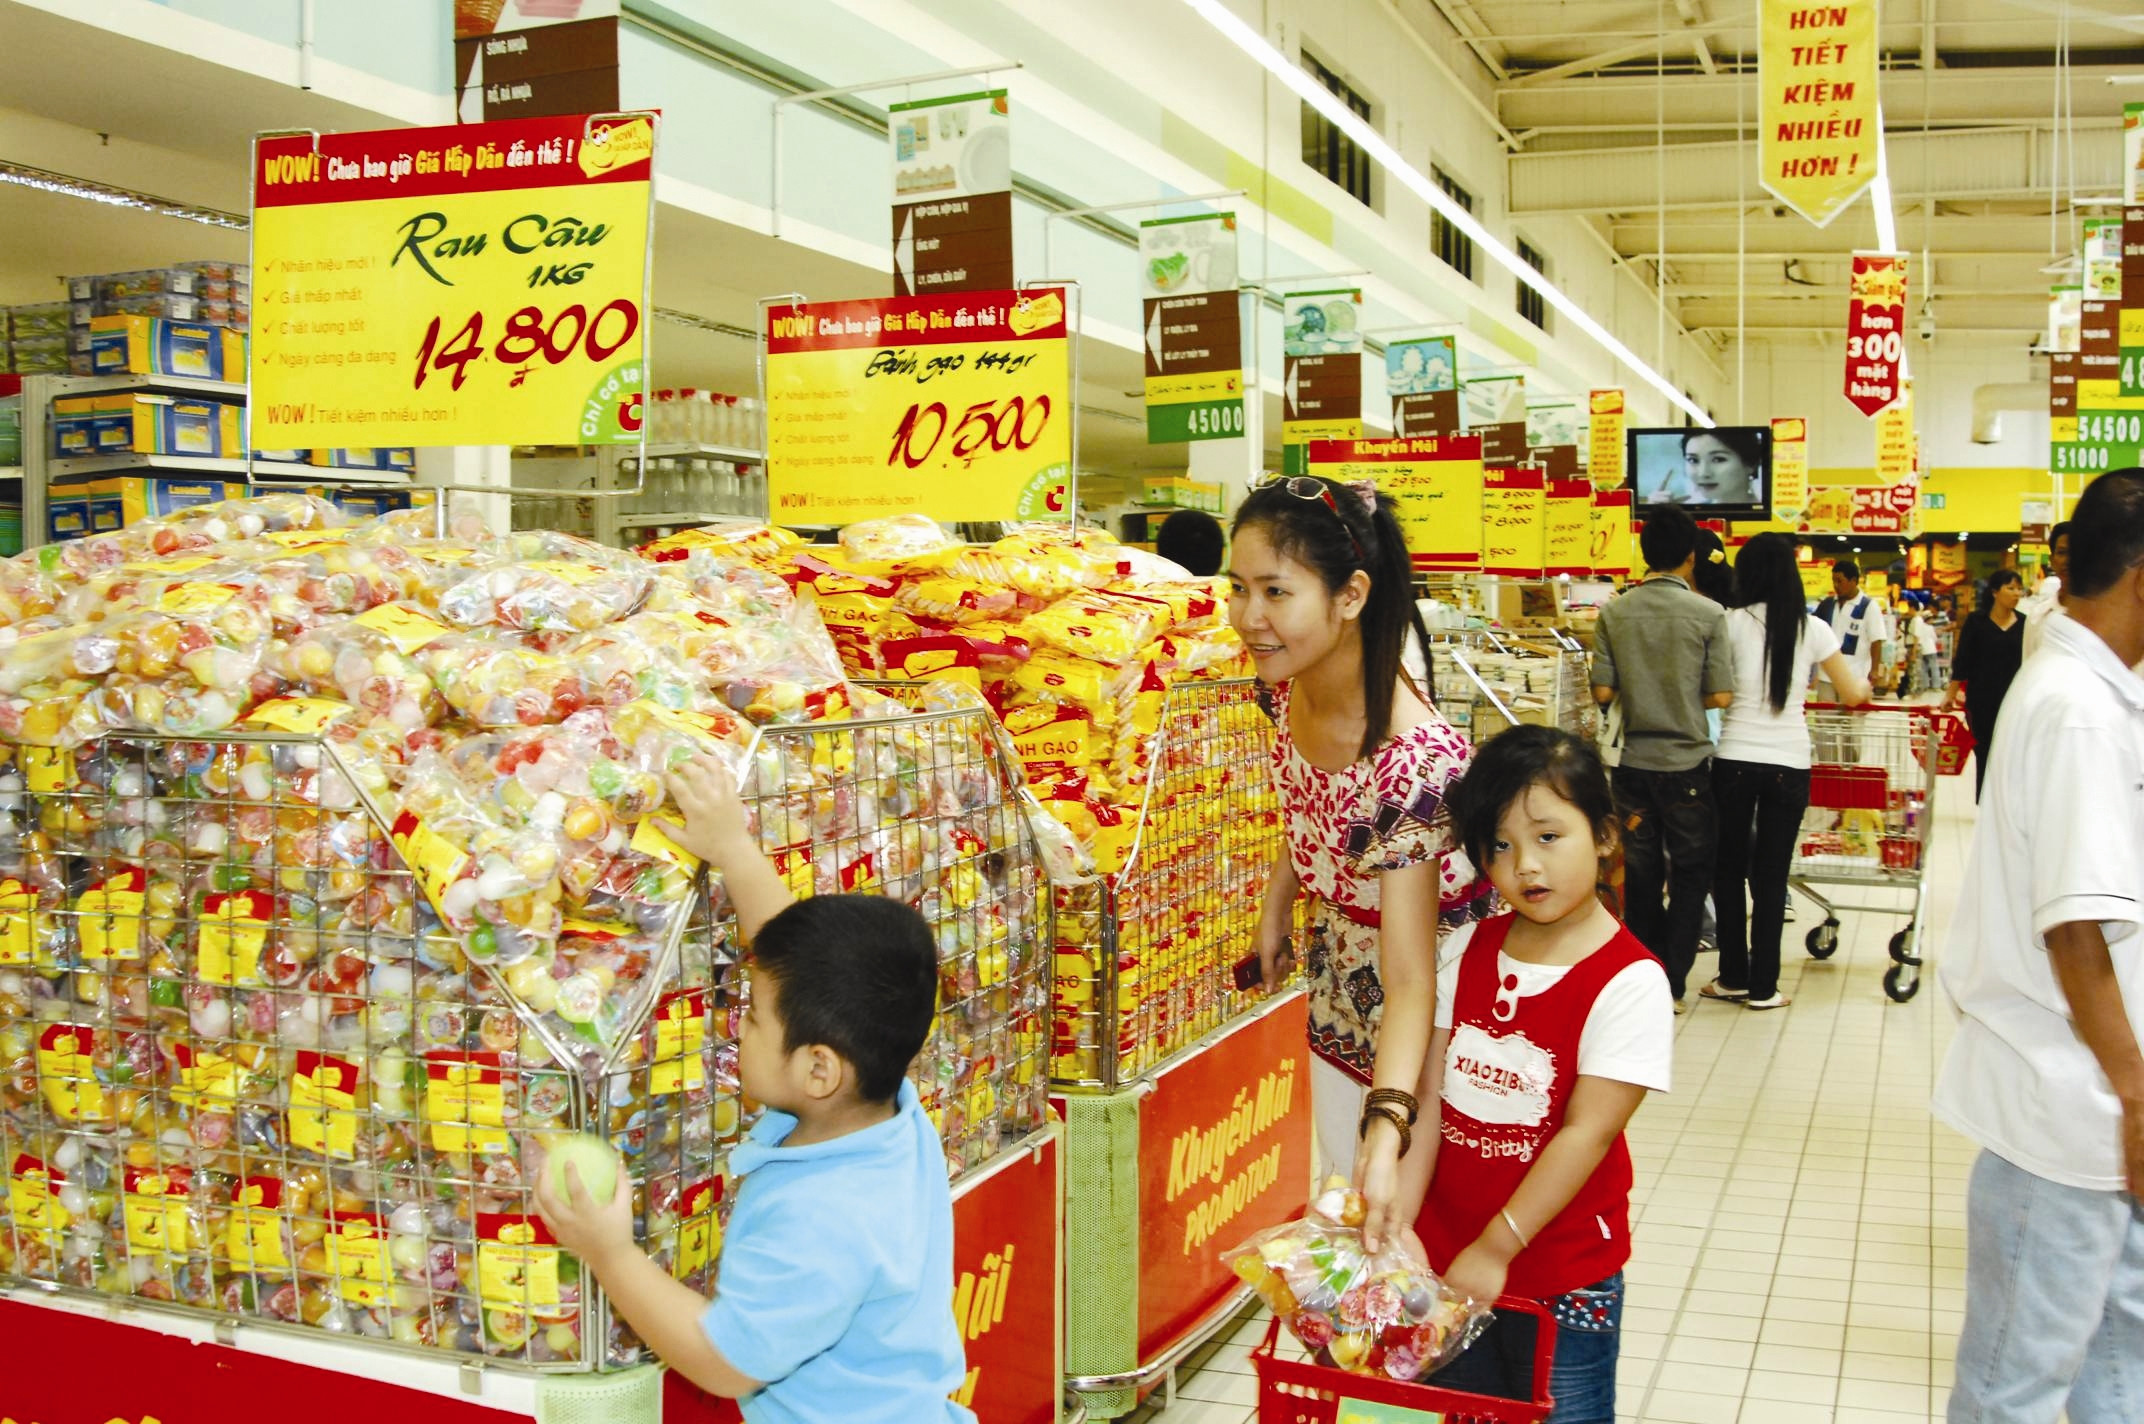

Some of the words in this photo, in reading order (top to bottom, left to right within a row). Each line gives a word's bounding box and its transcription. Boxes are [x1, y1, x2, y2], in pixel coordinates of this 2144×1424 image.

[1789, 6, 1847, 30] HƠN
[1790, 37, 1848, 66] TIẾT
[1783, 78, 1854, 106] KIỆM
[1777, 110, 1862, 142] NHIỀU
[264, 152, 321, 185] WOW!
[327, 156, 360, 181] Chưa
[363, 154, 387, 179] bao
[389, 153, 413, 184] giờ
[415, 150, 440, 175] Giá
[444, 144, 473, 178] Hấp
[476, 142, 504, 170] Dẫn
[506, 139, 534, 168] đến
[537, 136, 563, 166] thế
[1781, 155, 1839, 178] HƠN
[391, 212, 487, 287] Rau
[502, 214, 614, 255] Câu
[527, 263, 594, 288] 1KG
[772, 314, 815, 338] WOW!
[884, 314, 904, 332] Giá
[905, 310, 927, 334] Hấp
[930, 308, 952, 329] Dẫn
[954, 307, 975, 328] đến
[977, 306, 997, 327] thế
[1861, 313, 1894, 329] hơn
[1847, 331, 1902, 364] 300
[599, 376, 620, 398] có
[621, 367, 643, 384] tạ
[1856, 363, 1889, 382] mặt
[1851, 380, 1892, 401] hàng
[1187, 405, 1243, 434] 45000
[2077, 415, 2141, 442] 54500
[1353, 439, 1409, 457] Khuyến
[1411, 439, 1438, 454] Mãi
[2057, 447, 2109, 470] 51000
[1014, 742, 1037, 757] NH
[1043, 740, 1079, 758] GẠO
[1468, 1078, 1508, 1097] FASHION
[1166, 1086, 1254, 1202] Khuyến
[1252, 1058, 1295, 1136] Mãi
[1480, 1135, 1534, 1163] Bitty
[1184, 1143, 1281, 1256] PROMOTION
